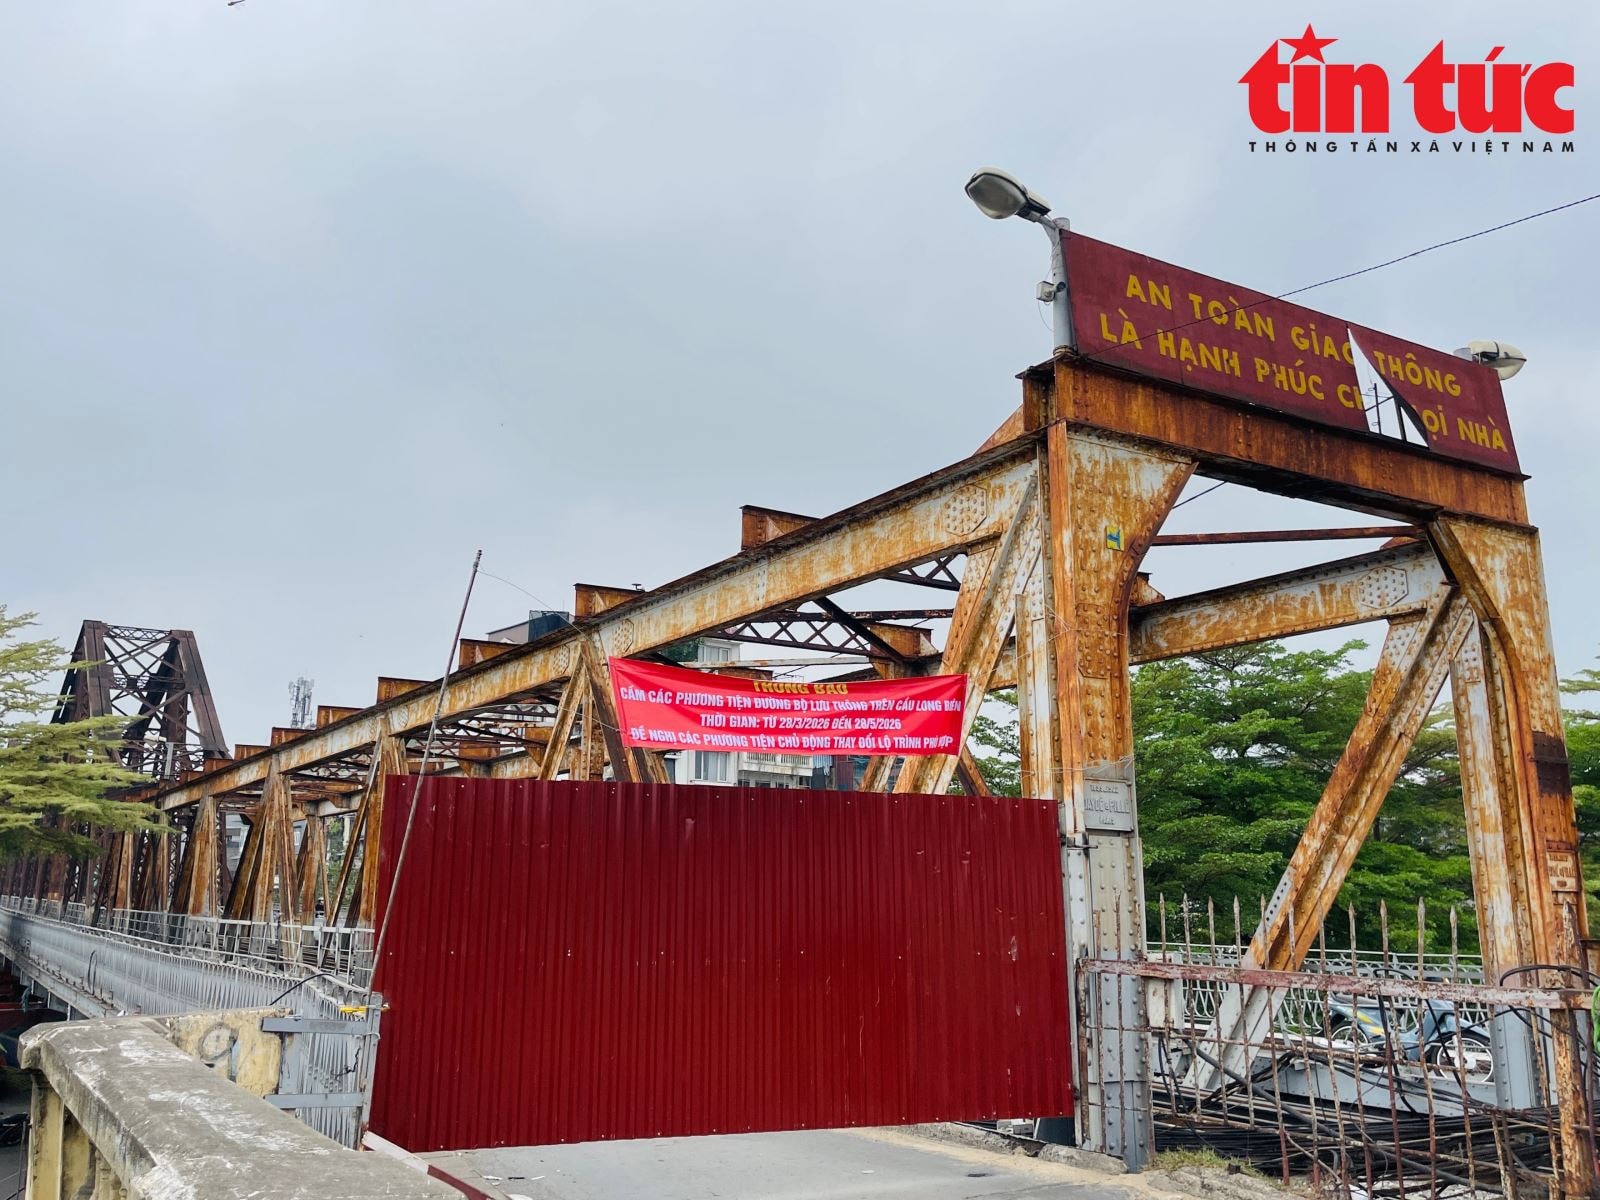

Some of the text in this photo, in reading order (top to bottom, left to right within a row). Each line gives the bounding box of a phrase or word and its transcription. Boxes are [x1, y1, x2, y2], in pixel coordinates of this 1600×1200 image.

[1126, 274, 1173, 310] AN
[1188, 292, 1276, 342] TOÀN
[1372, 350, 1462, 397] THÔNG
[1100, 307, 1142, 350] LÀ
[1157, 328, 1241, 378] HẠNH
[1254, 357, 1325, 400] PHÚC
[1456, 414, 1509, 453] NHÀ
[648, 688, 673, 705] CÁC
[676, 692, 724, 707] PHƯƠNG
[726, 695, 752, 711] TIỆN
[754, 696, 791, 711] ĐƯỜNG
[793, 698, 808, 713] BỘ
[833, 699, 868, 711] THÔNG
[869, 698, 896, 711] TRÊN
[916, 700, 942, 712] LONG
[700, 711, 902, 730] THỜI GIAN: TỪ 28/3/2026 ĐẾN 28/5/2026
[648, 729, 677, 746] NGHỊ
[677, 732, 702, 745] CÁC
[703, 734, 748, 748] PHƯƠNG
[750, 735, 775, 750] TIỆN
[778, 733, 799, 748] CHỦ
[802, 734, 831, 751] ĐỘNG
[833, 736, 856, 749] THAY
[877, 735, 891, 751] LỘ
[894, 734, 921, 749] TRÌNH
